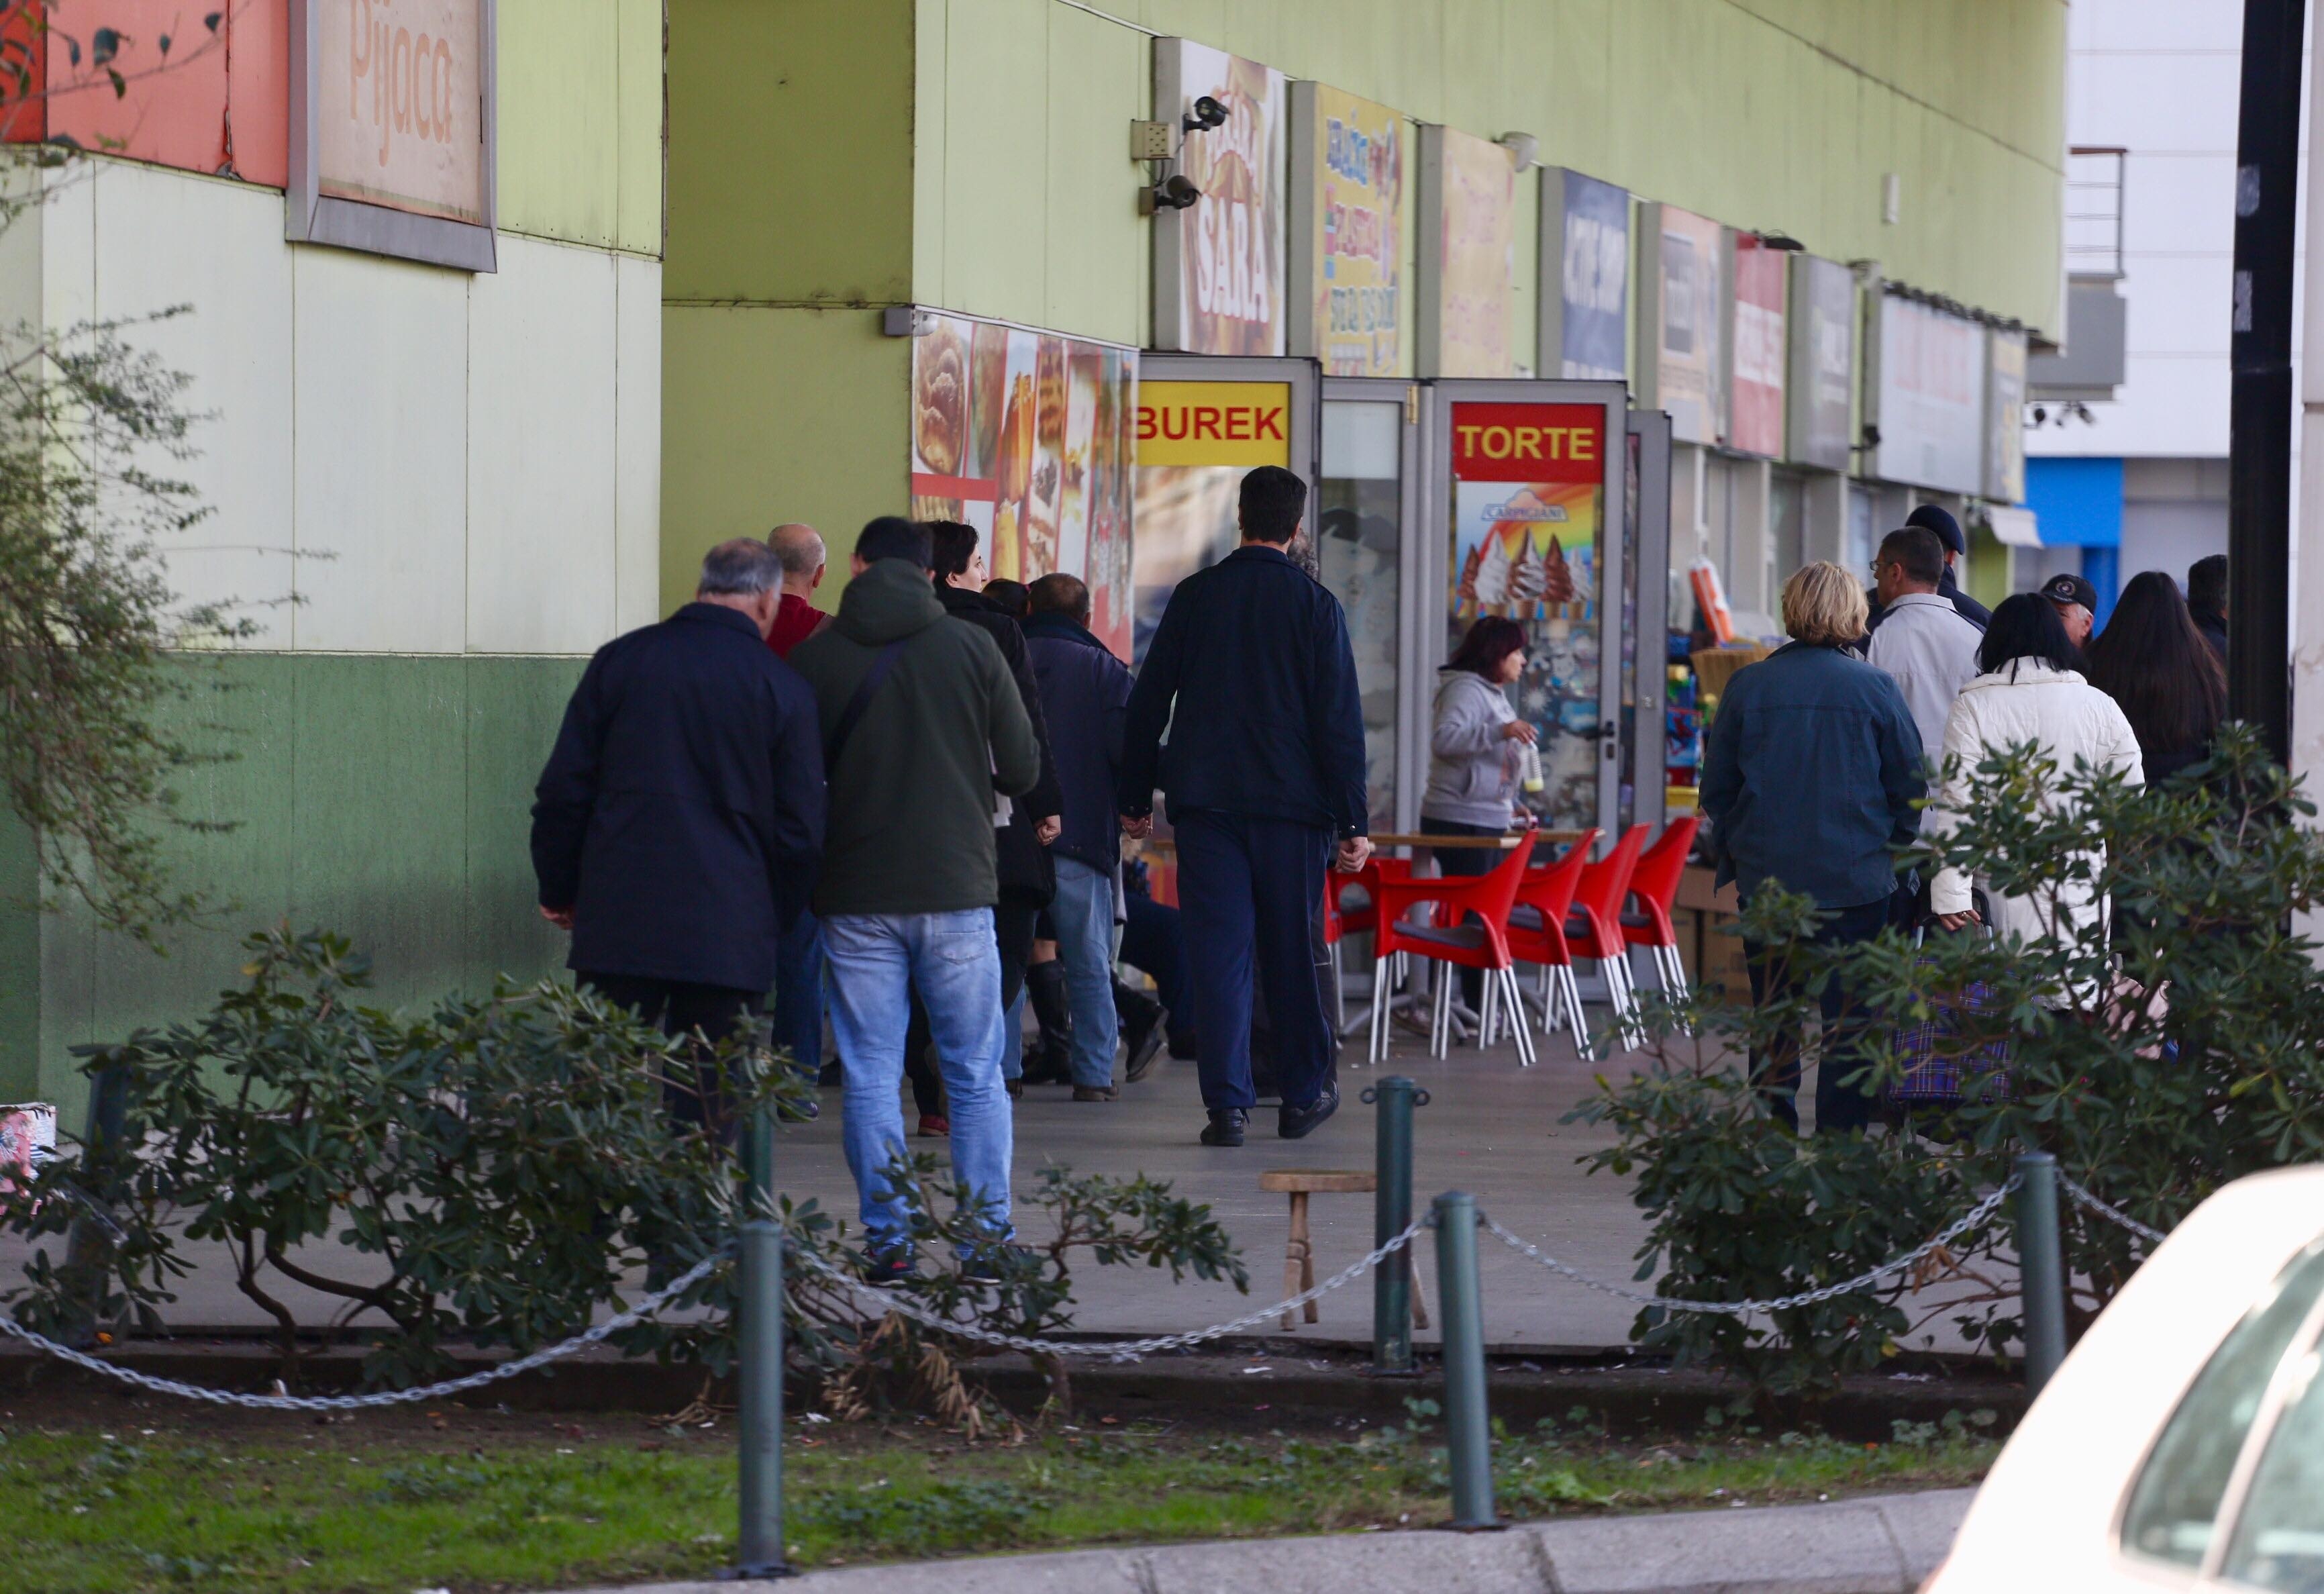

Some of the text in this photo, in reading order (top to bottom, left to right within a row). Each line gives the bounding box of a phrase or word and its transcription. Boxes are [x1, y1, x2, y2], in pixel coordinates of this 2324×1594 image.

[350, 0, 452, 168] Pijaca
[1197, 193, 1270, 323] SARA
[1127, 406, 1283, 441] BUREK
[1456, 425, 1595, 460] TORTE
